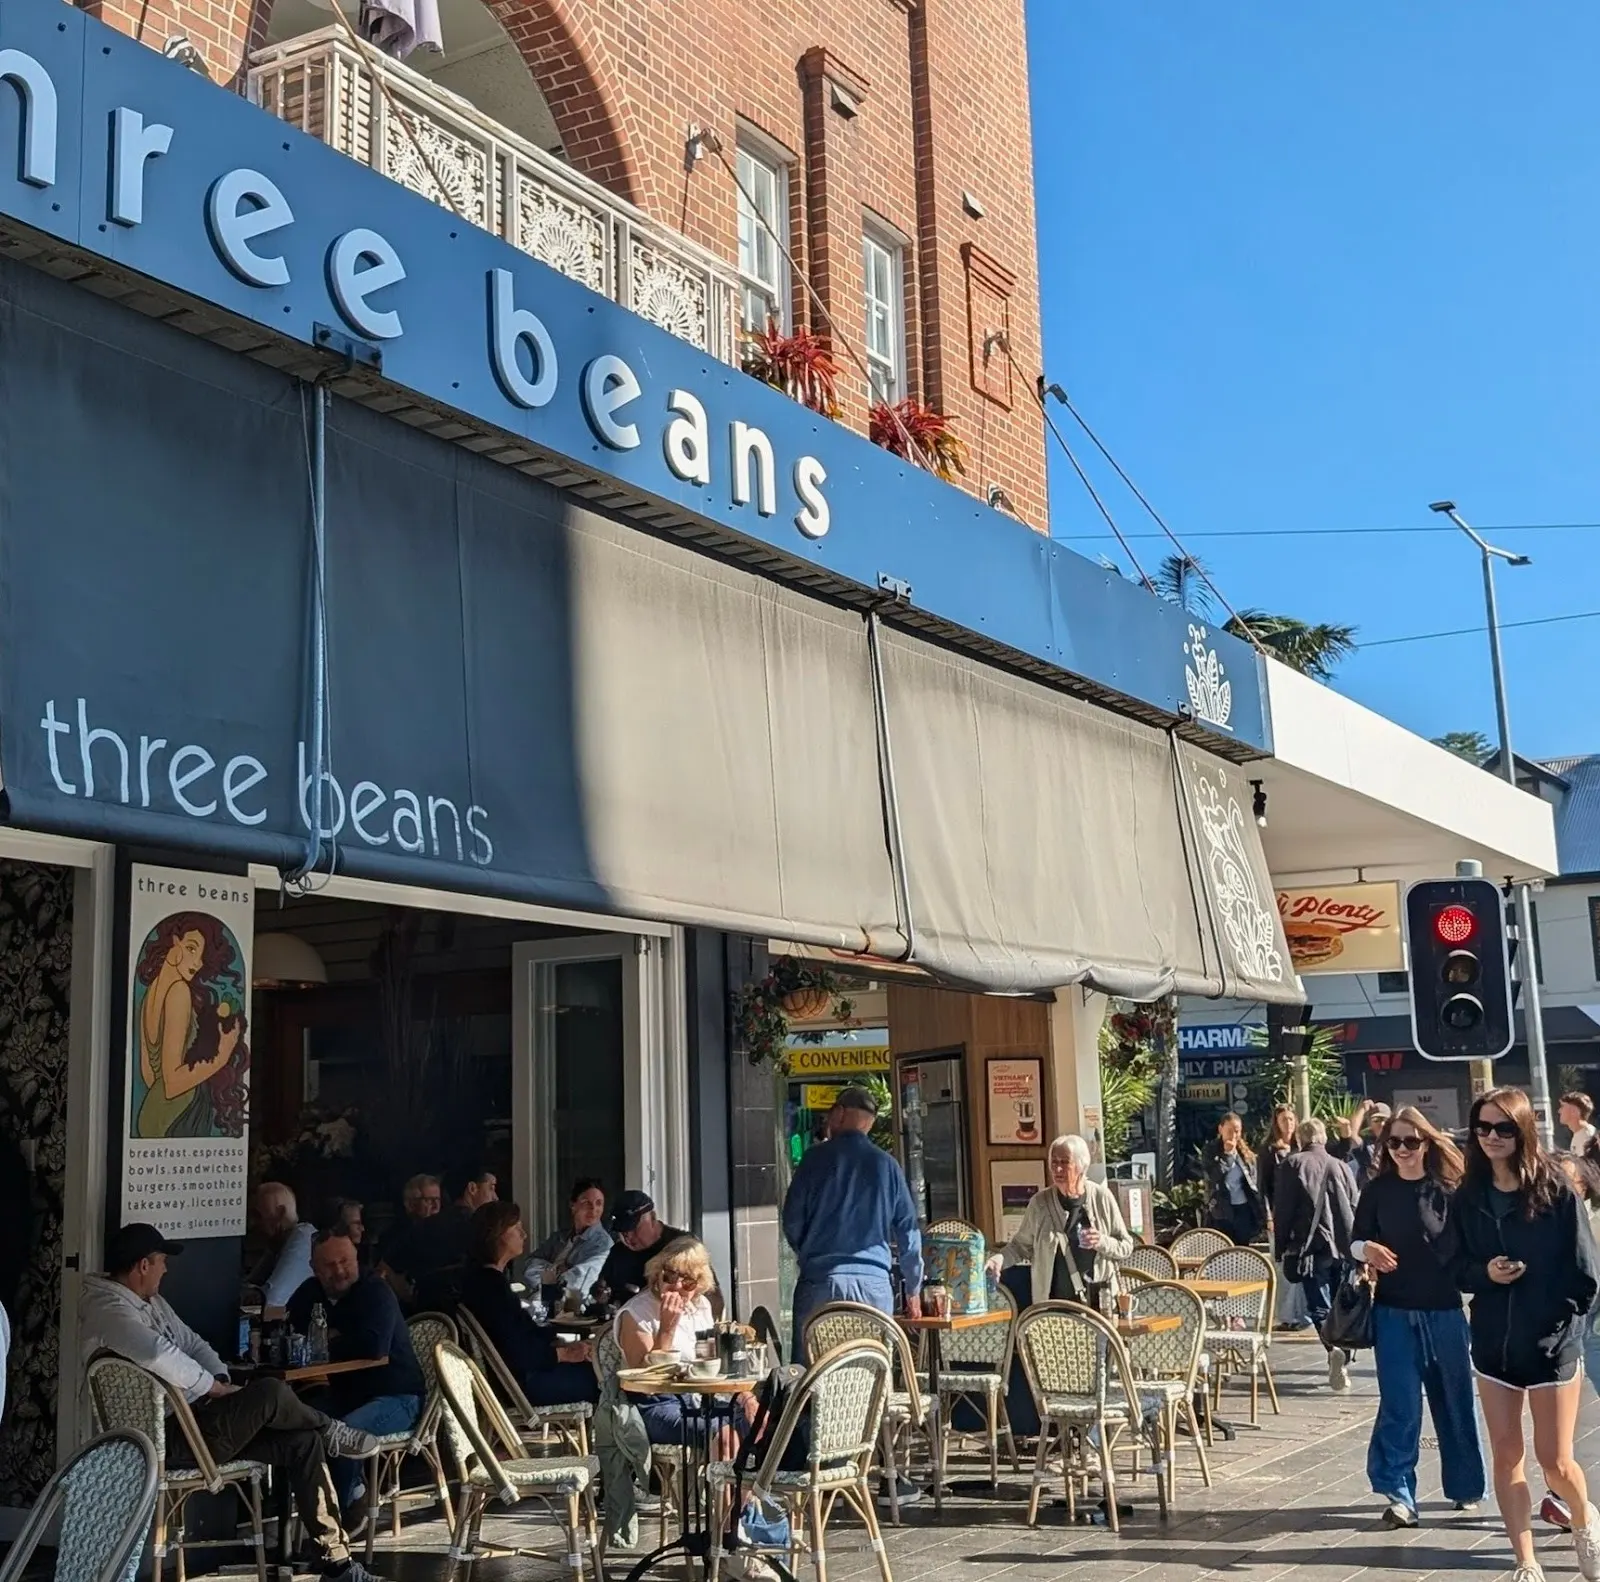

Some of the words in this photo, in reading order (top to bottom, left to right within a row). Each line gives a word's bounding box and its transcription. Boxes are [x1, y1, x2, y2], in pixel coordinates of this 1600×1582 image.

[487, 268, 830, 539] beans
[40, 698, 267, 825] three
[298, 741, 494, 865] beans
[138, 878, 187, 896] three
[198, 884, 249, 903] beans
[1290, 896, 1388, 931] Plenty
[800, 1050, 890, 1068] CONVENIENC
